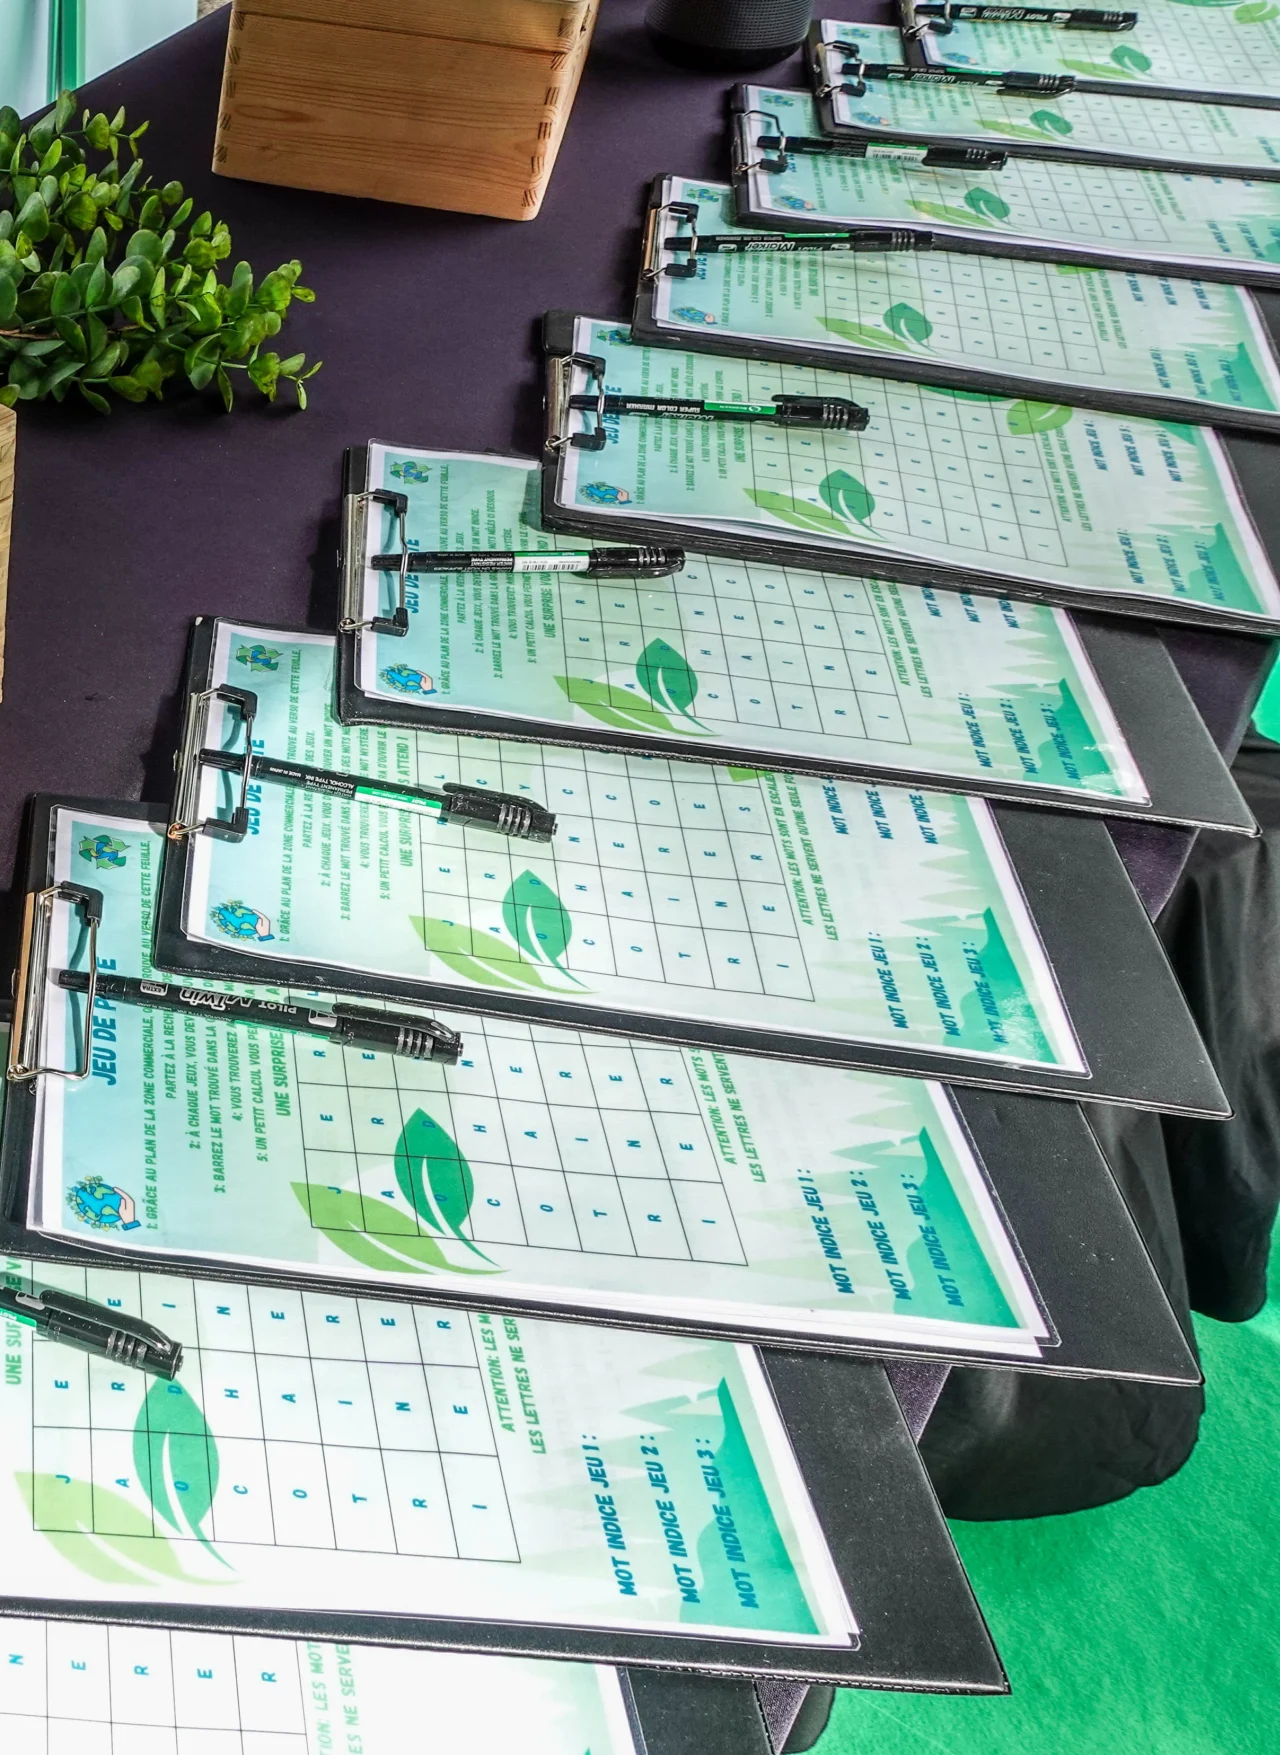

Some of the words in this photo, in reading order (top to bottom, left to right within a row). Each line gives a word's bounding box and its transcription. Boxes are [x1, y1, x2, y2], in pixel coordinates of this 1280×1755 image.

[744, 242, 795, 251] Marker
[539, 588, 554, 621] SURPRISE
[542, 624, 556, 638] UNE
[959, 704, 977, 719] JEU
[964, 722, 986, 748] INDICE
[397, 743, 409, 777] ATTEND
[976, 750, 993, 768] MOT
[787, 785, 806, 808] SEULE
[823, 785, 843, 814] INDICE
[773, 806, 786, 817] EN
[777, 818, 792, 838] SONT
[831, 816, 849, 835] MOT
[870, 945, 889, 966] JEU
[142, 985, 165, 994] EXTRA
[876, 969, 901, 1002] INDICE
[179, 987, 226, 1011] Twin
[257, 1003, 297, 1014] PILOT
[888, 1006, 909, 1029] MOT
[92, 1015, 117, 1041] DE
[141, 1016, 155, 1079] COMMERCIALE,
[91, 1047, 117, 1086] JEU
[269, 1033, 289, 1088] SURPRISE
[692, 1056, 711, 1082] MOTS
[204, 1066, 220, 1101] TROUVÉ
[700, 1084, 717, 1102] LES
[142, 1082, 155, 1106] ZONE
[143, 1109, 155, 1120] LA
[209, 1105, 221, 1123] MOT
[273, 1092, 291, 1117] UNE
[726, 1098, 742, 1112] NE
[144, 1123, 156, 1136] DE
[210, 1127, 223, 1139] LE
[706, 1104, 738, 1165] ATTENTION:
[732, 1114, 760, 1159] LETTRES
[144, 1140, 157, 1165] PLAN
[209, 1142, 225, 1182] BARREZ
[144, 1168, 157, 1182] AU
[748, 1163, 767, 1183] LES
[142, 1185, 158, 1220] GRÂCE
[801, 1187, 825, 1212] JEU
[811, 1216, 842, 1259] INDICE
[829, 1263, 855, 1294] MOT
[107, 1298, 122, 1307] E
[216, 1306, 231, 1316] N
[270, 1310, 286, 1320] E
[325, 1314, 340, 1324] R
[381, 1318, 396, 1326] E
[436, 1320, 452, 1330] R
[480, 1328, 497, 1351] LES
[508, 1346, 525, 1363] NE
[5, 1354, 22, 1385] UNE
[55, 1380, 69, 1389] E
[110, 1381, 126, 1391] R
[224, 1388, 240, 1399] H
[488, 1353, 516, 1432] ATTENTION:
[281, 1393, 297, 1403] A
[515, 1366, 540, 1426] LETTRES
[394, 1401, 411, 1412] N
[453, 1405, 469, 1414] E
[526, 1429, 547, 1455] LES
[581, 1444, 600, 1452] 1
[640, 1445, 660, 1456] 2
[56, 1473, 71, 1485] J
[584, 1455, 609, 1489] JEU
[647, 1461, 671, 1494] JEU
[115, 1478, 130, 1488] A
[233, 1484, 249, 1494] C
[292, 1489, 308, 1499] O
[351, 1493, 368, 1503] T
[412, 1498, 428, 1508] R
[595, 1493, 626, 1550] INDICE
[658, 1500, 689, 1557] INDICE
[610, 1558, 638, 1596] MOT
[673, 1564, 701, 1604] MOT
